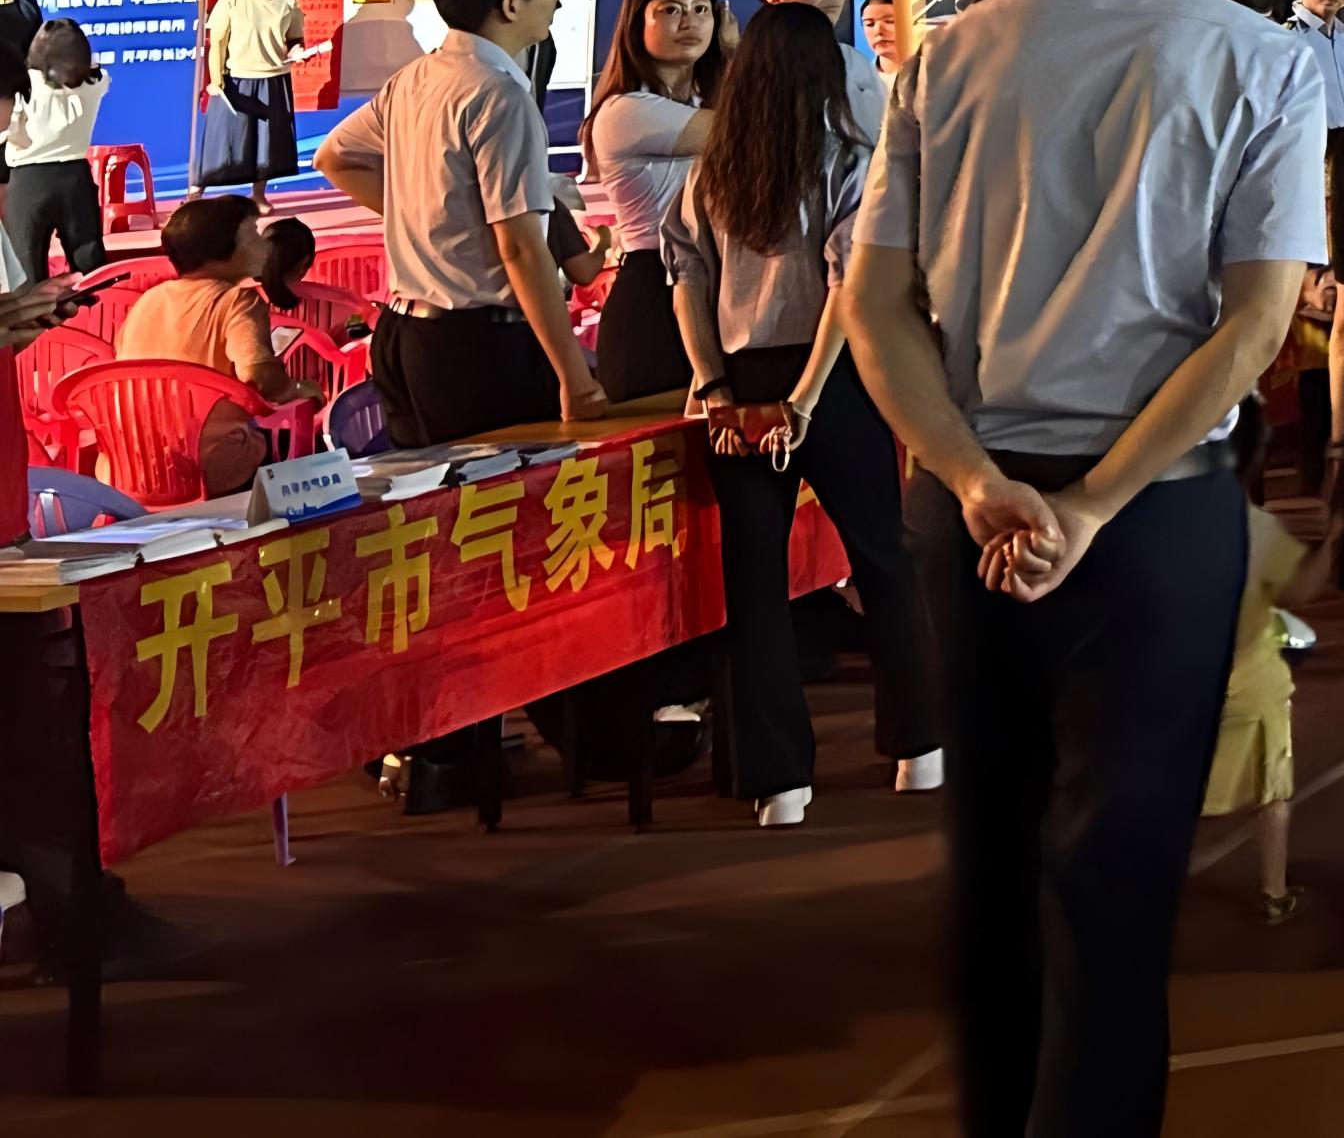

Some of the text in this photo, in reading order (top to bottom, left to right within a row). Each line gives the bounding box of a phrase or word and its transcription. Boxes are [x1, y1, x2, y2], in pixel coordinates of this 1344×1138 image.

[136, 439, 688, 734] 开平市气象局
